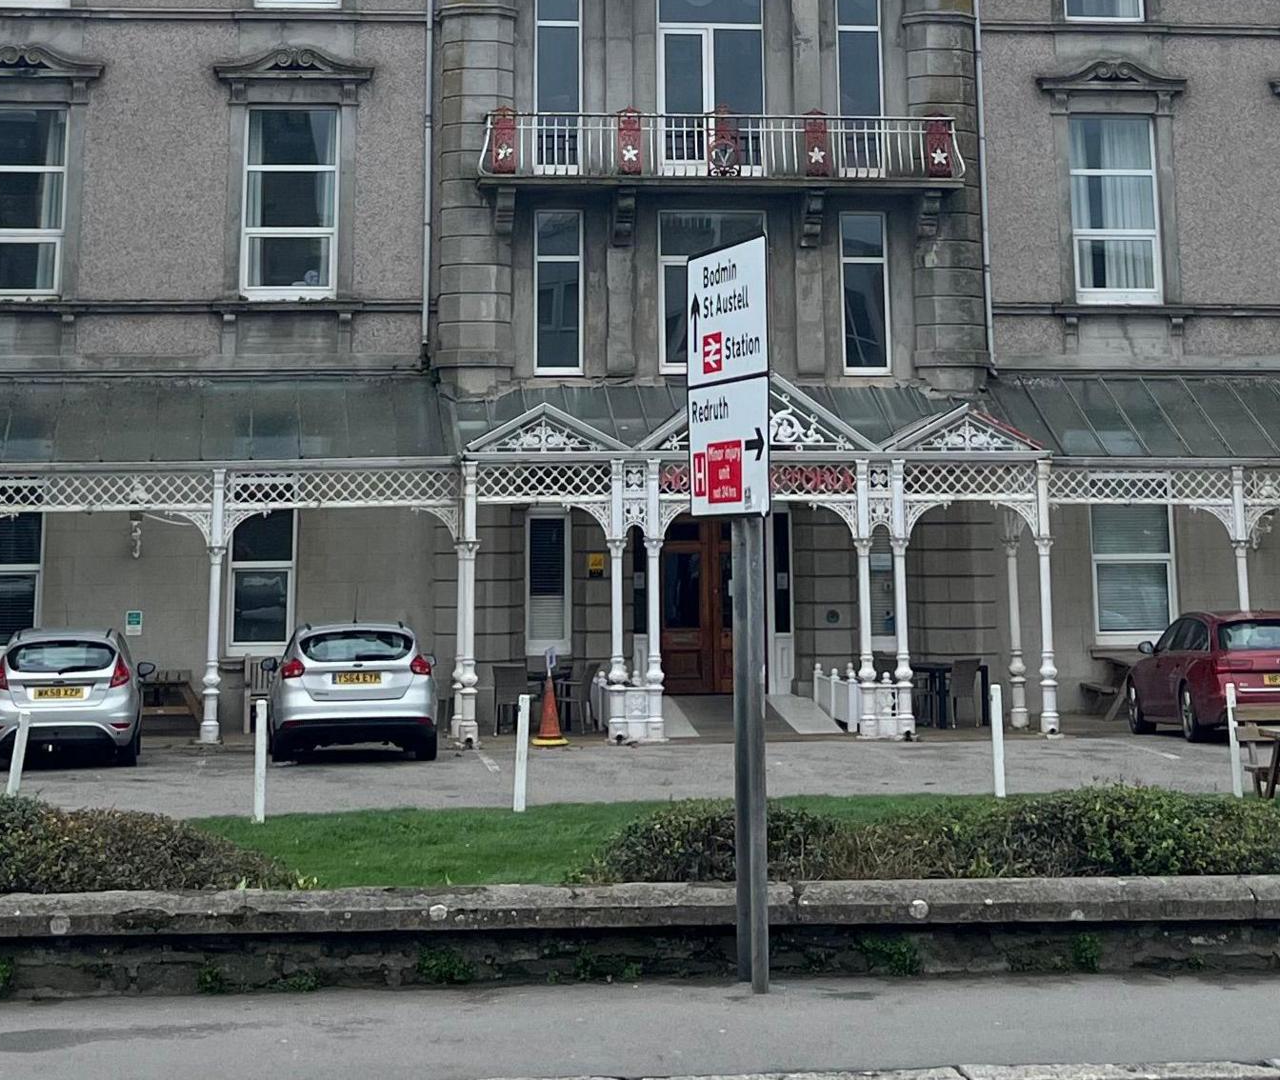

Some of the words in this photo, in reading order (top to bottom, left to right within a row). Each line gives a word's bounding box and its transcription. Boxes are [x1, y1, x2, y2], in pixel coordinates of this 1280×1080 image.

[703, 258, 737, 289] Bodmin
[703, 295, 714, 319] St
[716, 285, 749, 316] Austell
[725, 332, 760, 360] Station
[692, 396, 729, 423] Redruth
[708, 447, 724, 461] Minor
[724, 445, 741, 463] injury
[694, 456, 705, 492] H
[718, 465, 730, 480] unit
